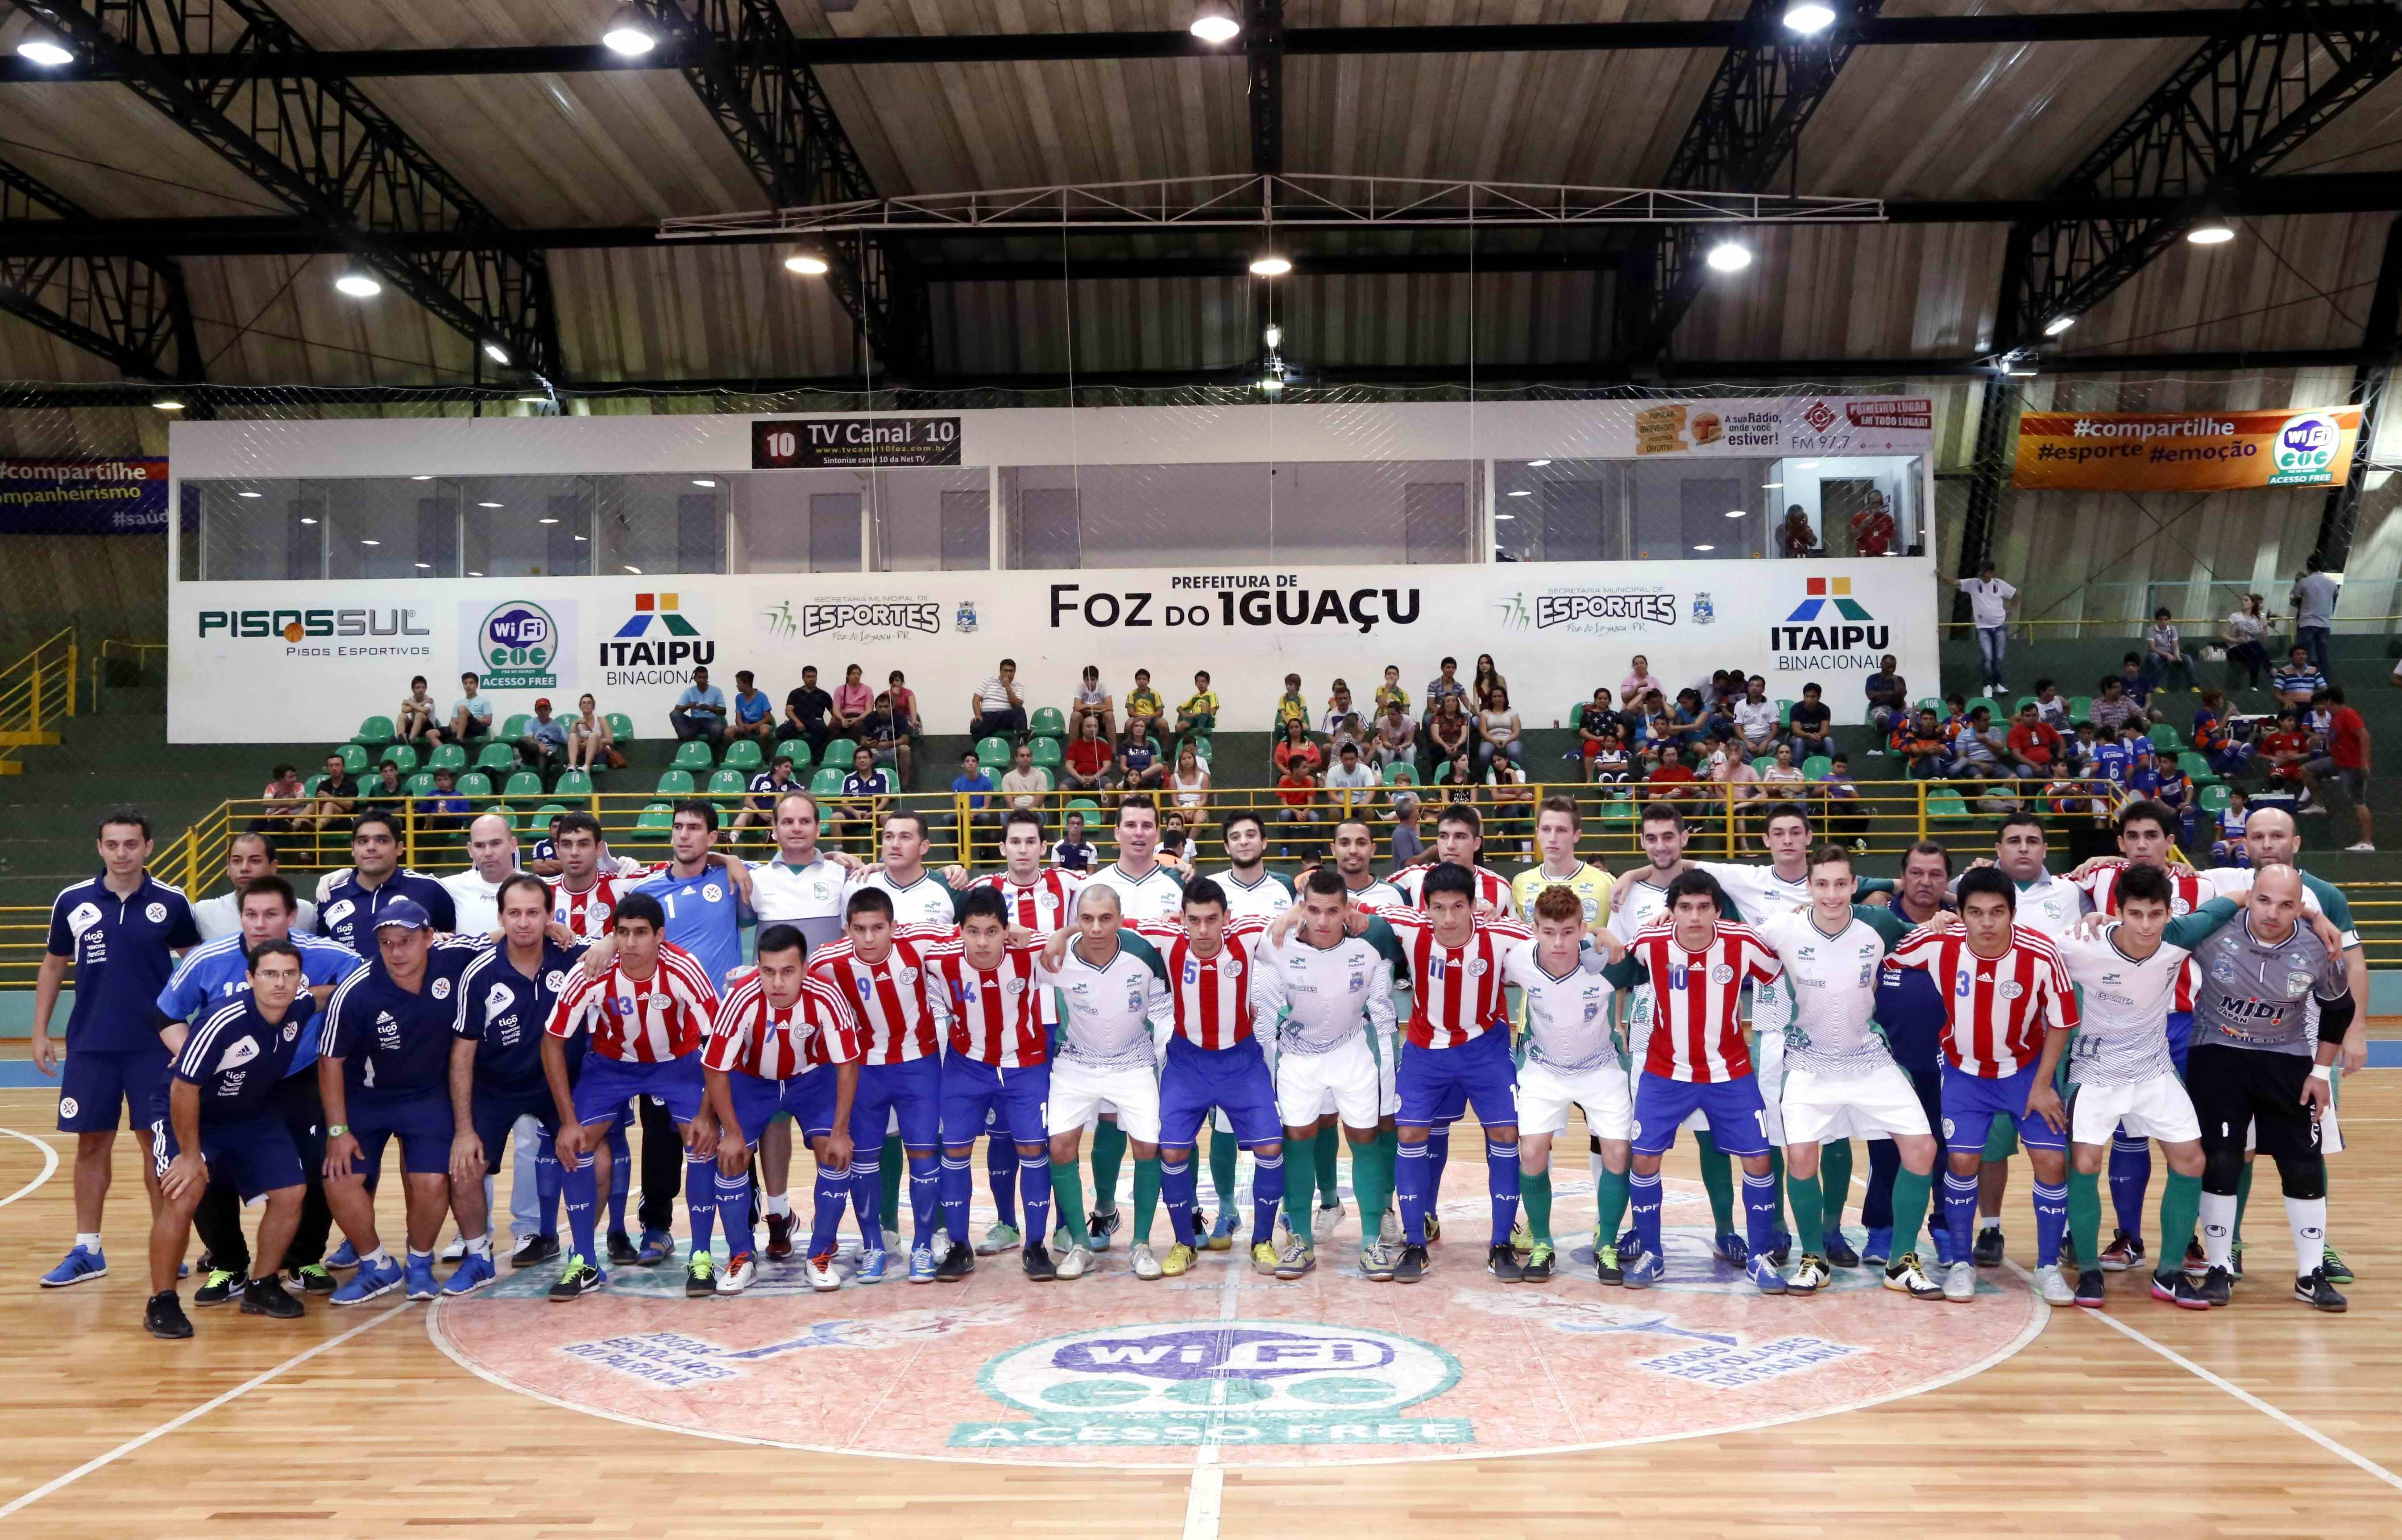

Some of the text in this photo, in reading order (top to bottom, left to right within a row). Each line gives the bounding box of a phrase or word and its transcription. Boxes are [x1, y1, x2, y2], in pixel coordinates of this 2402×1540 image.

[1850, 402, 1927, 415] PRIMEIRO LUGAR
[1748, 412, 1782, 424] Rádio,
[1861, 416, 1873, 425] EM
[1875, 416, 1896, 425] TODO
[808, 421, 954, 444] TV Canal 10
[1729, 423, 1771, 432] onde você
[2073, 417, 2235, 441] #compartilhe
[767, 432, 795, 457] 10
[1728, 432, 1778, 445] estiver!
[1792, 436, 1850, 449] FM 97.7
[2038, 440, 2258, 464] #esporte #emoção
[823, 456, 857, 464] Sintonize
[2269, 473, 2331, 484] ACESSO FREE
[0, 486, 141, 507] mpanheirismo
[112, 508, 169, 526] #saúd
[1172, 574, 1298, 589] PREFEITURA DE
[1218, 588, 1420, 634] IGUAÇU
[1536, 594, 1676, 629] ESPORTES
[803, 603, 940, 637] ESPORTES
[1566, 623, 1582, 633] Foz
[832, 631, 848, 641] Foz
[1771, 625, 1889, 651] ITAIPU
[600, 640, 714, 667] ITAIPU
[1779, 655, 1883, 670] BINACIONAL
[482, 677, 555, 686] ACESSO FREE
[607, 670, 697, 685] BINACIONA
[1925, 699, 1939, 709] 106
[1044, 709, 1052, 717] 46
[565, 718, 570, 726] 5
[613, 717, 618, 726] 6
[689, 743, 694, 753] 3
[739, 743, 744, 752] 3
[789, 742, 794, 751] 3
[1039, 738, 1043, 747] 5
[348, 750, 353, 760] 7
[397, 747, 402, 756] 8
[446, 748, 451, 756] 9
[723, 772, 732, 781] 36
[2110, 761, 2119, 779] 6
[419, 776, 428, 785] 15
[470, 776, 479, 785] 16
[571, 774, 580, 783] 18
[2216, 788, 2226, 798] 28
[664, 894, 676, 919] 1
[1183, 960, 1197, 984] 5
[1666, 963, 1688, 990] 10
[857, 977, 871, 1000] 9
[1956, 970, 1970, 997] 3
[951, 979, 977, 1003] 14
[2095, 991, 2134, 1006] ESPORTES
[607, 996, 634, 1016] 13
[2217, 1007, 2249, 1024] JAPAN
[766, 1020, 776, 1043] 7
[715, 1193, 744, 1202] APF
[1945, 1196, 1974, 1206] APF
[1632, 1203, 1660, 1213] APF
[967, 1423, 1460, 1442] ACESSO FREE
